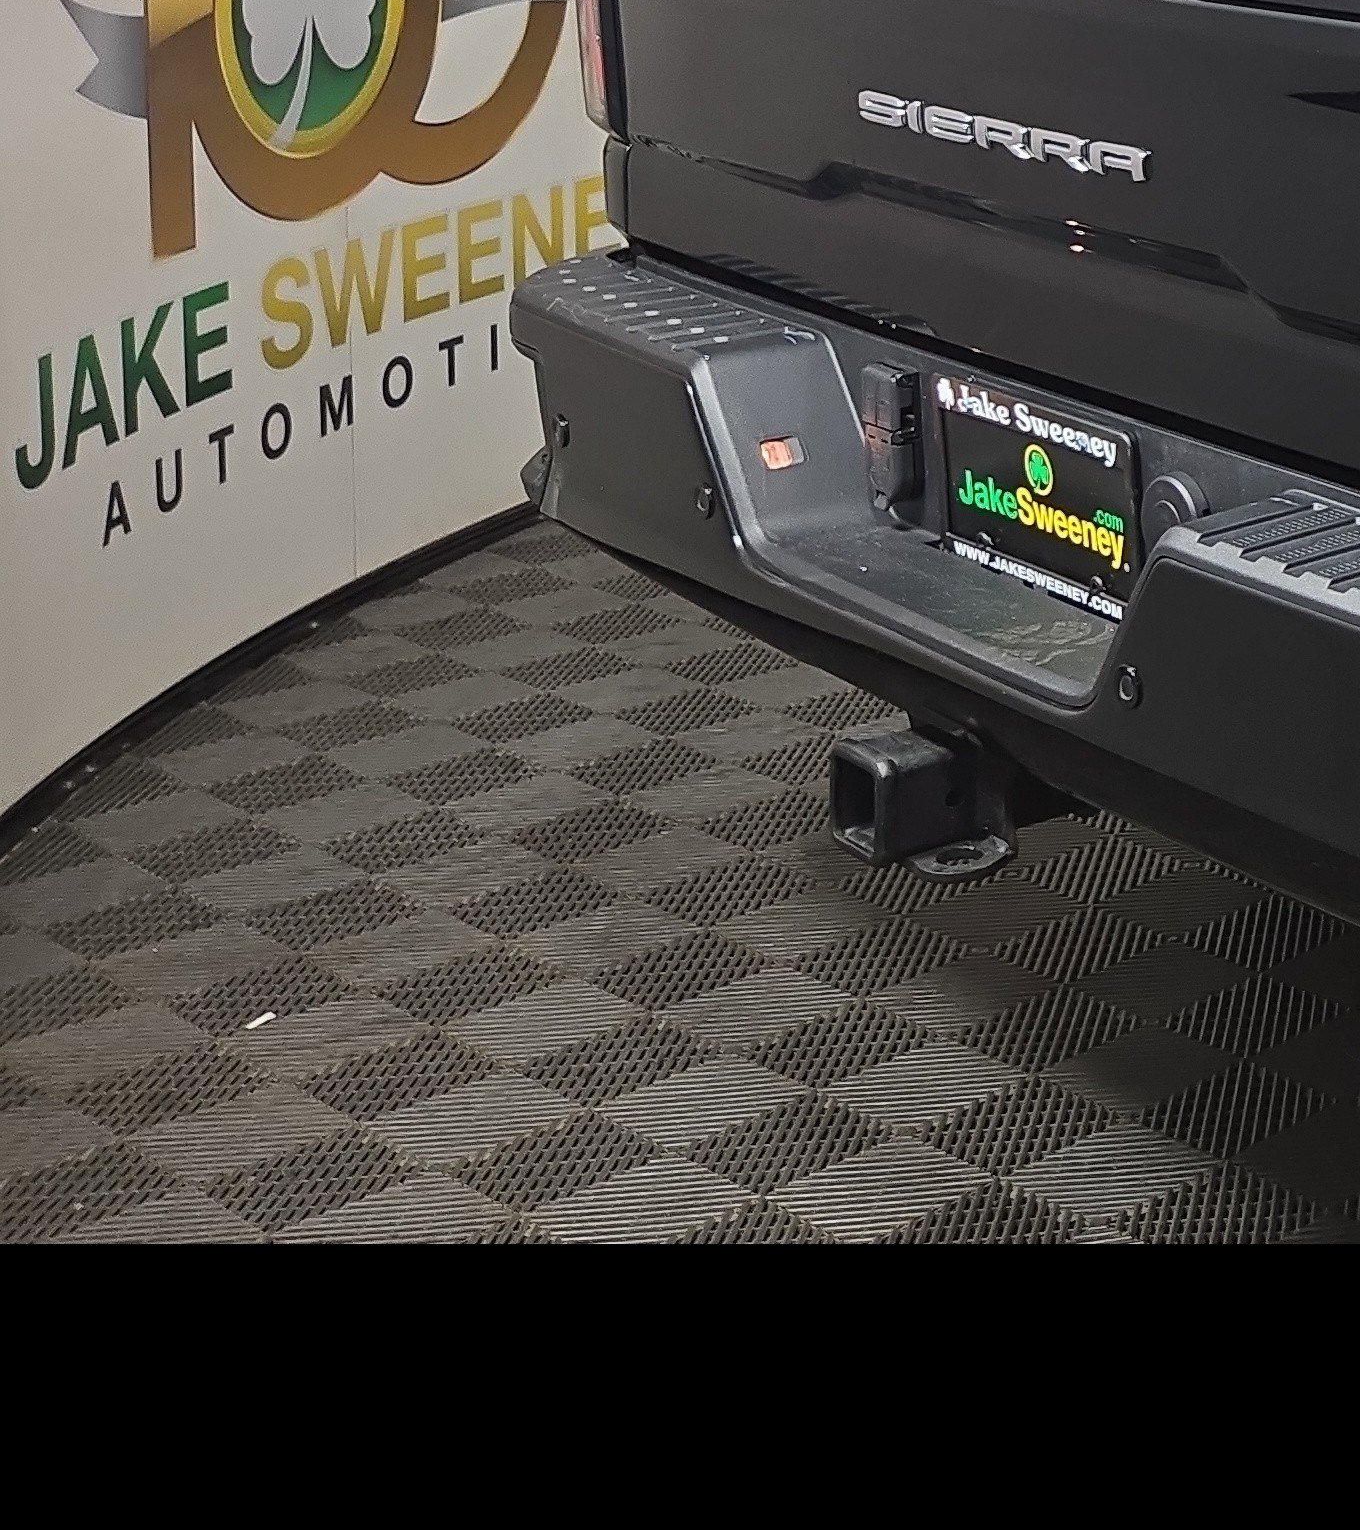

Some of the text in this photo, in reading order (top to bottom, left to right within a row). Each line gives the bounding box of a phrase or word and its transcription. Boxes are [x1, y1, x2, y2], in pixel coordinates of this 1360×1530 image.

[858, 89, 1152, 183] SIERRA
[14, 175, 612, 491] JAKE SWEENE
[102, 323, 500, 547] AUTOMOTI
[957, 384, 1118, 468] Jake Sweeney
[952, 540, 1123, 621] WWW.JAKESWEENEY.COM
